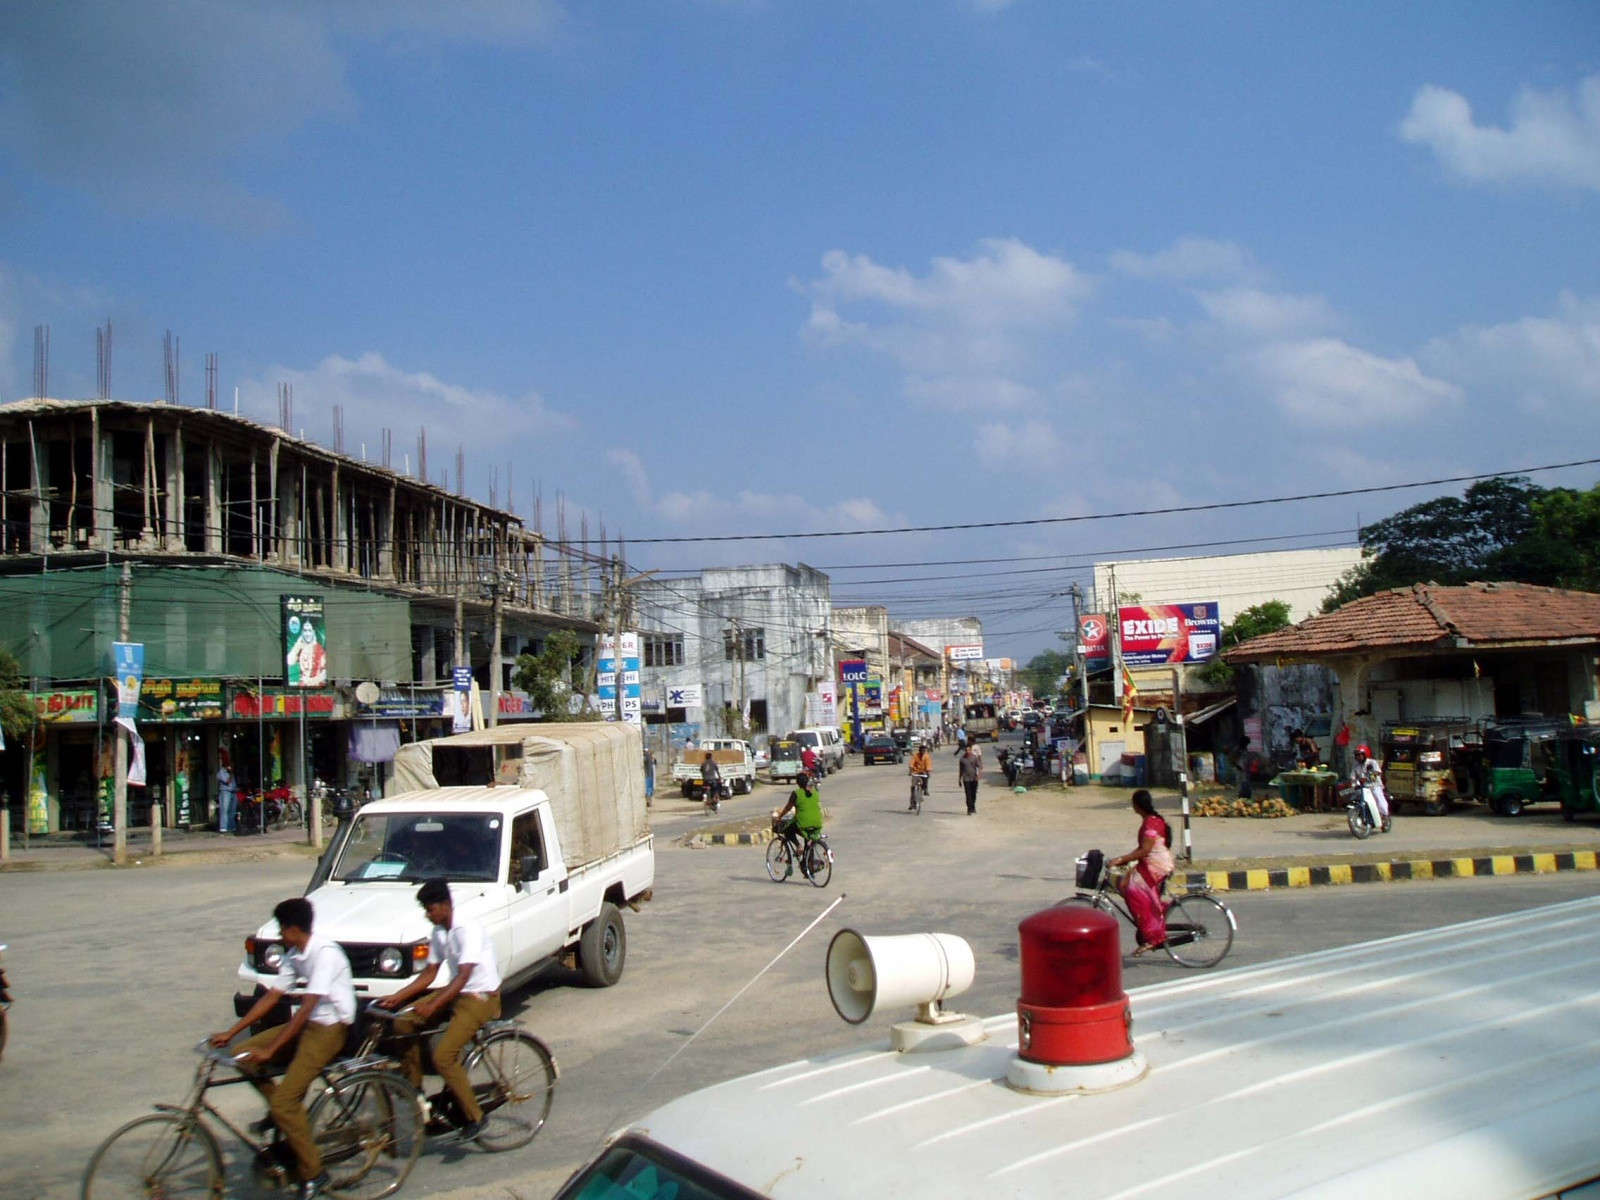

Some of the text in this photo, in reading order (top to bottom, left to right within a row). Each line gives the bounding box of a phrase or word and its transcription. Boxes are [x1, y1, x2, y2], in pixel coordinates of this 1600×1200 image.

[1122, 617, 1179, 635] EXIDE
[1184, 618, 1218, 627] Browns
[601, 642, 634, 650] INER
[601, 674, 635, 683] HITHI
[601, 700, 637, 710] PHPS
